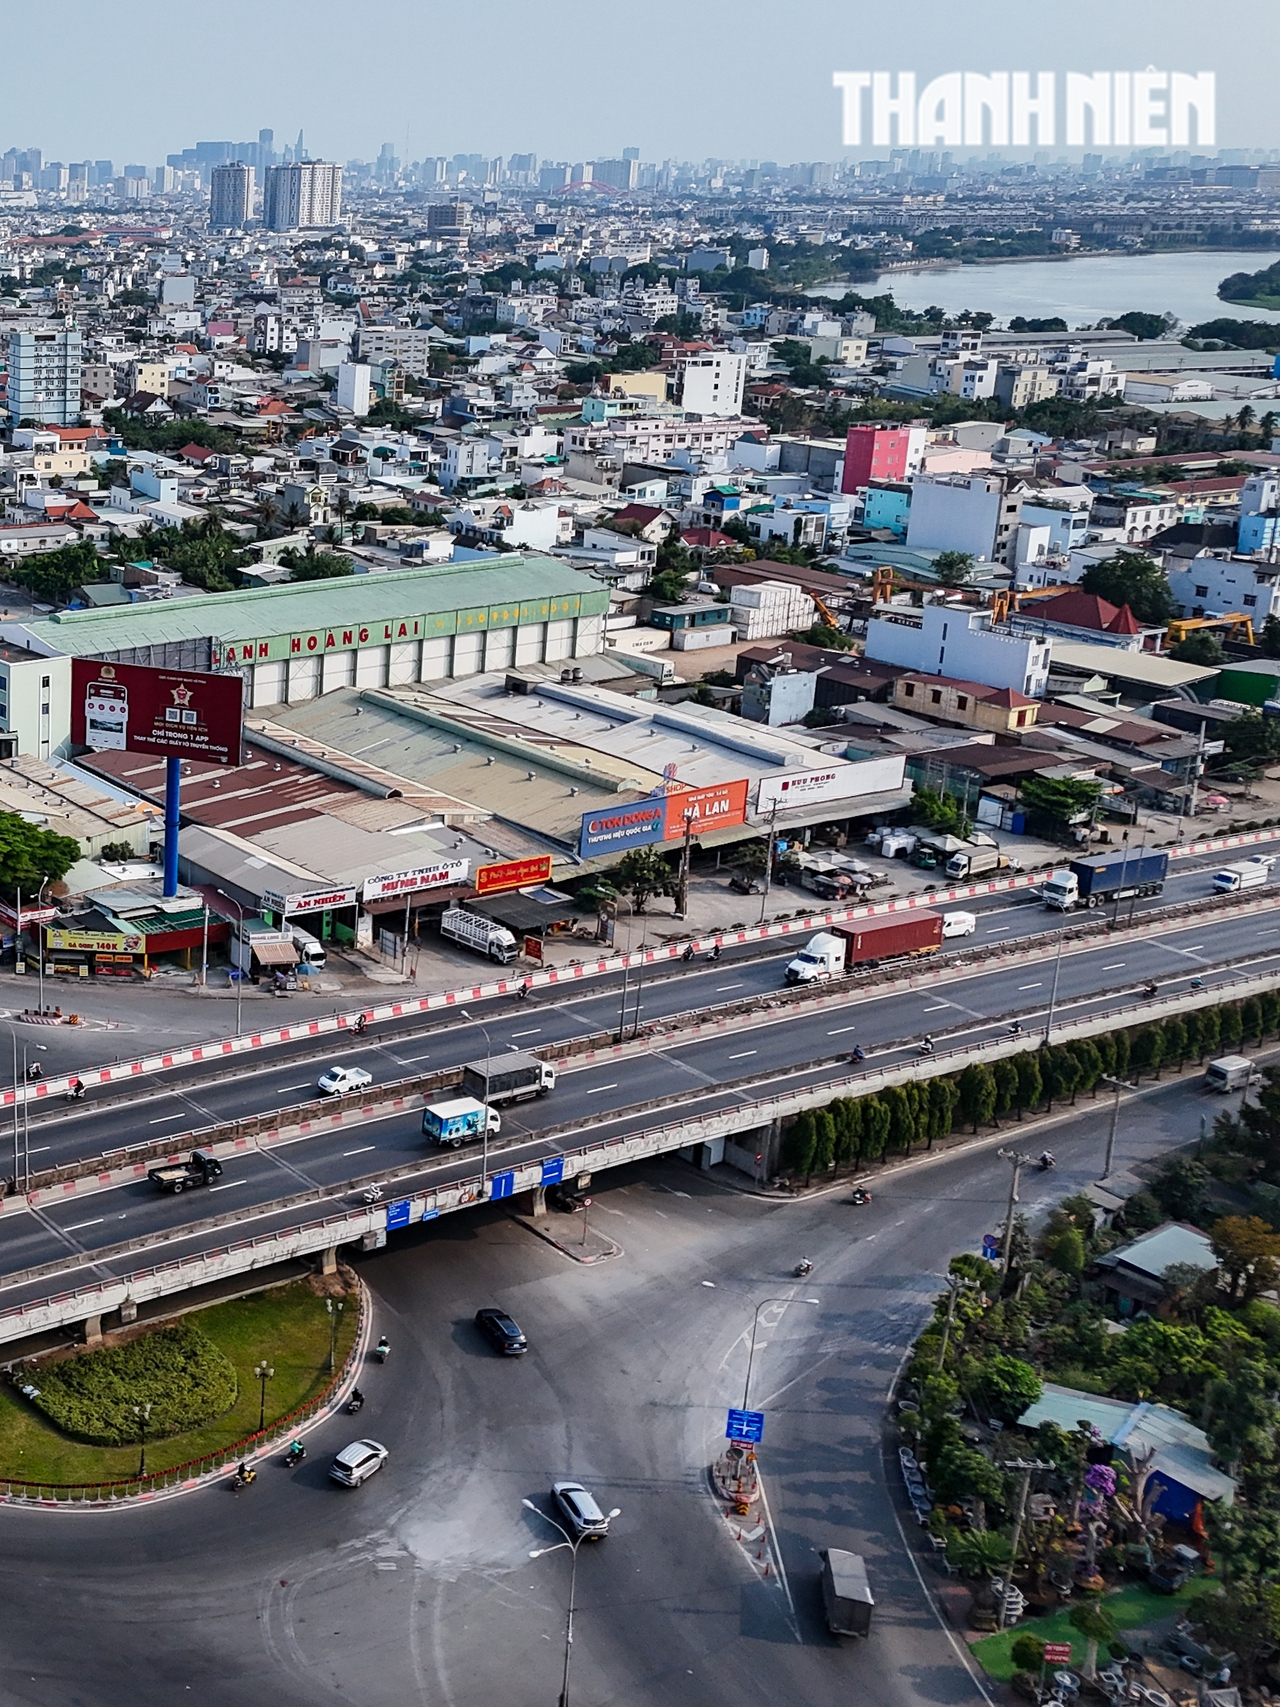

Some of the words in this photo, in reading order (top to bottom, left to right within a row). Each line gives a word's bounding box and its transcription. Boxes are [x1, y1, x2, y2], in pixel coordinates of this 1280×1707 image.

[291, 628, 369, 653] HOÀNG
[384, 621, 418, 639] LAI
[165, 731, 188, 740] TRONG
[705, 799, 730, 816] LAN
[368, 874, 394, 884] CÔNG
[395, 871, 409, 879] TY
[411, 865, 440, 876] TNHH
[442, 860, 462, 870] ÔTÔ
[381, 877, 418, 892] HƯNG
[420, 871, 449, 884] NAM
[296, 899, 311, 909] AN
